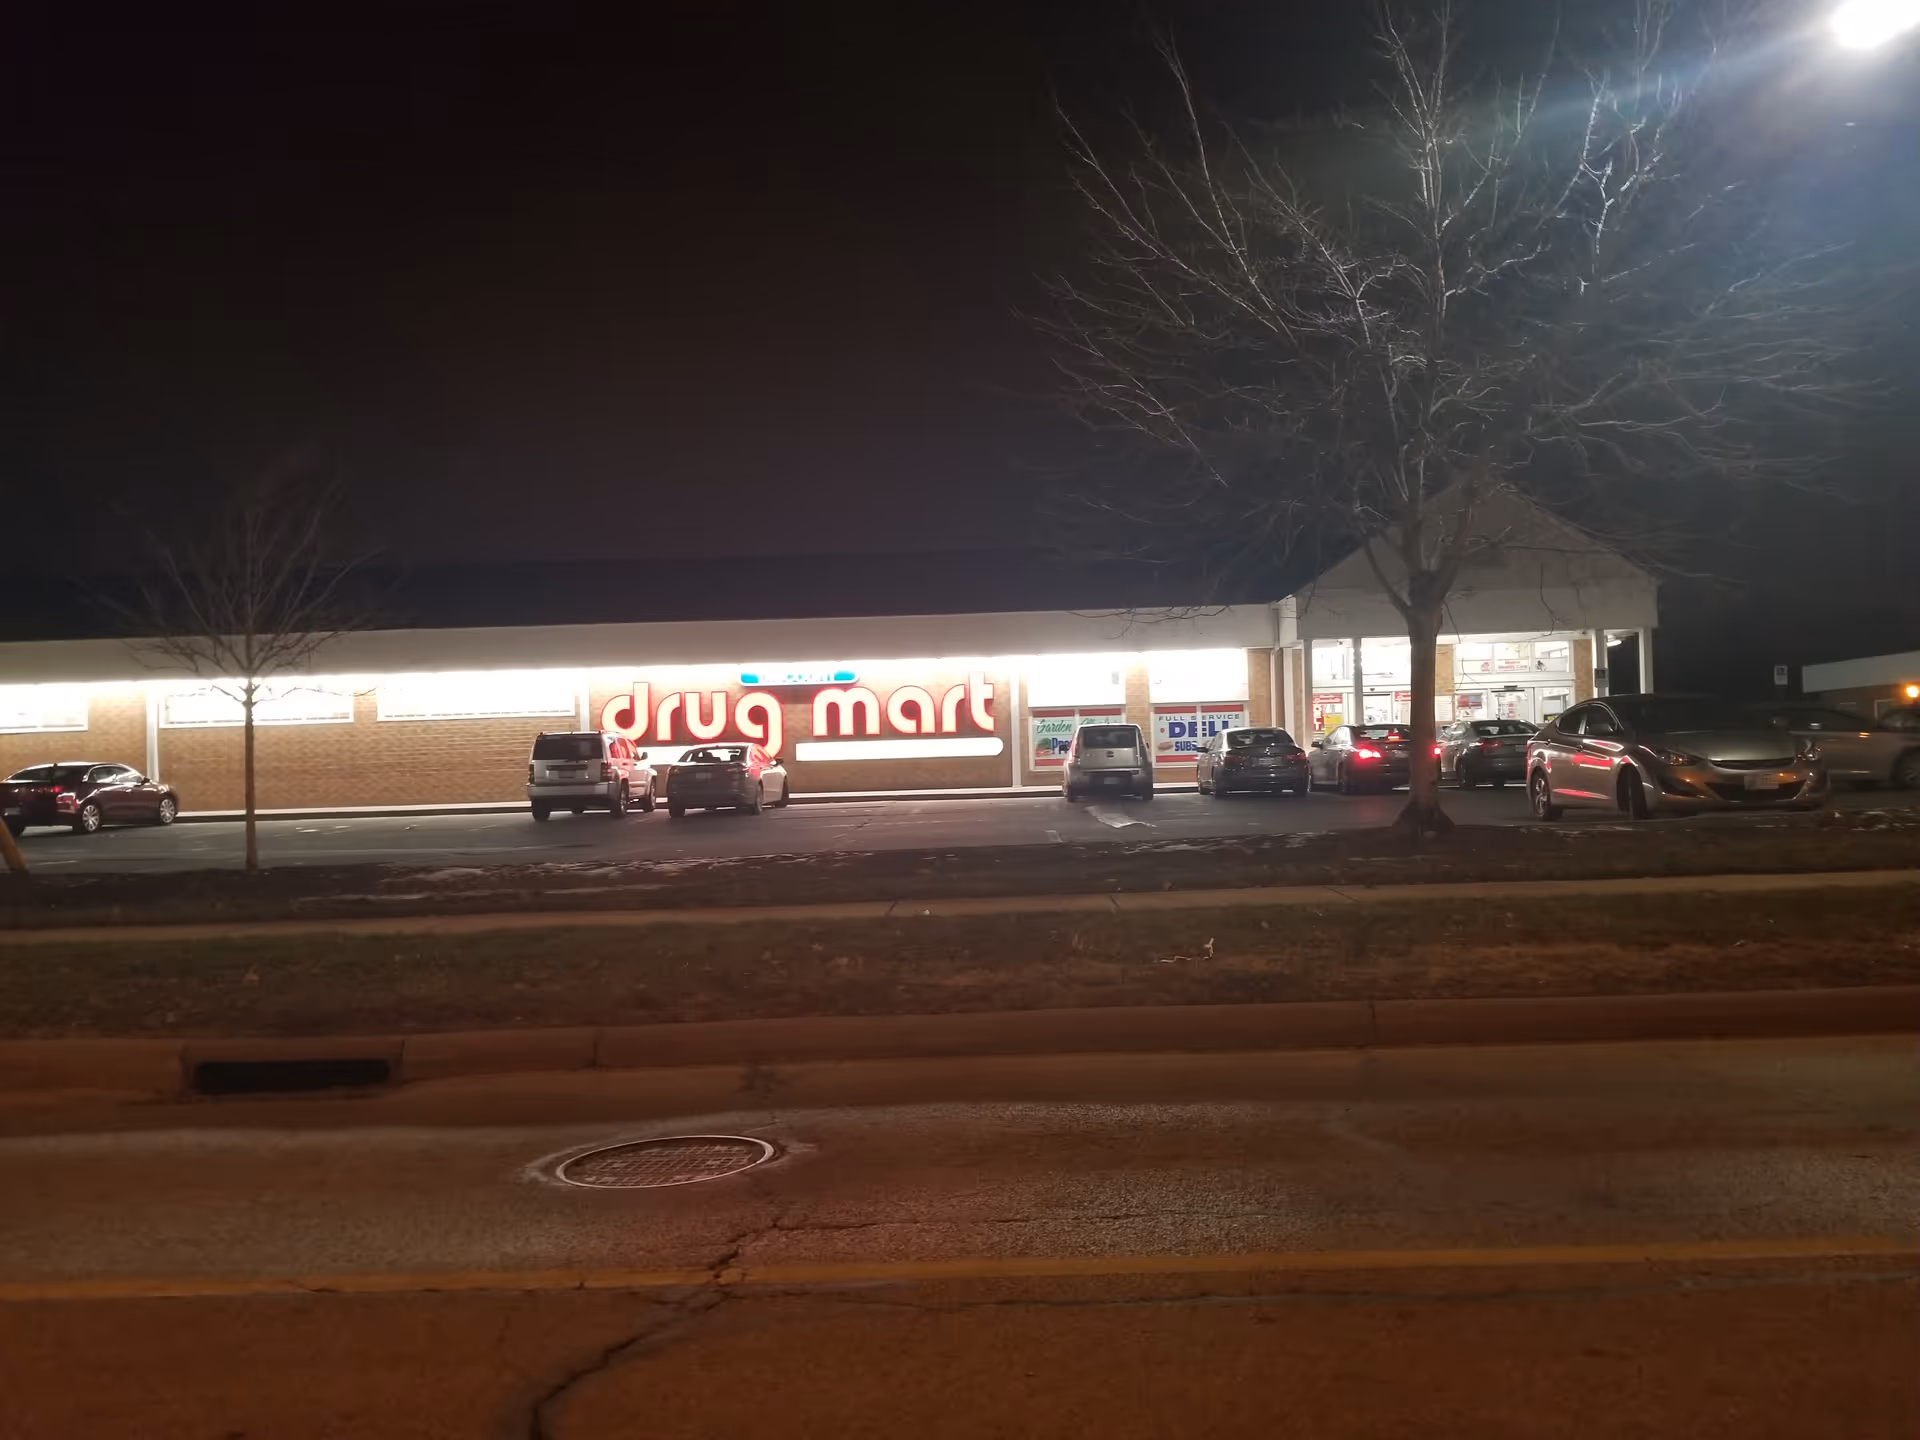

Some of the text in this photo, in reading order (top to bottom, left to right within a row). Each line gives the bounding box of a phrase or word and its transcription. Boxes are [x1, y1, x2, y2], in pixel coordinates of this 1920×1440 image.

[601, 672, 996, 760] drug mart
[1190, 713, 1241, 721] SERVICE
[1036, 718, 1072, 734] Garden
